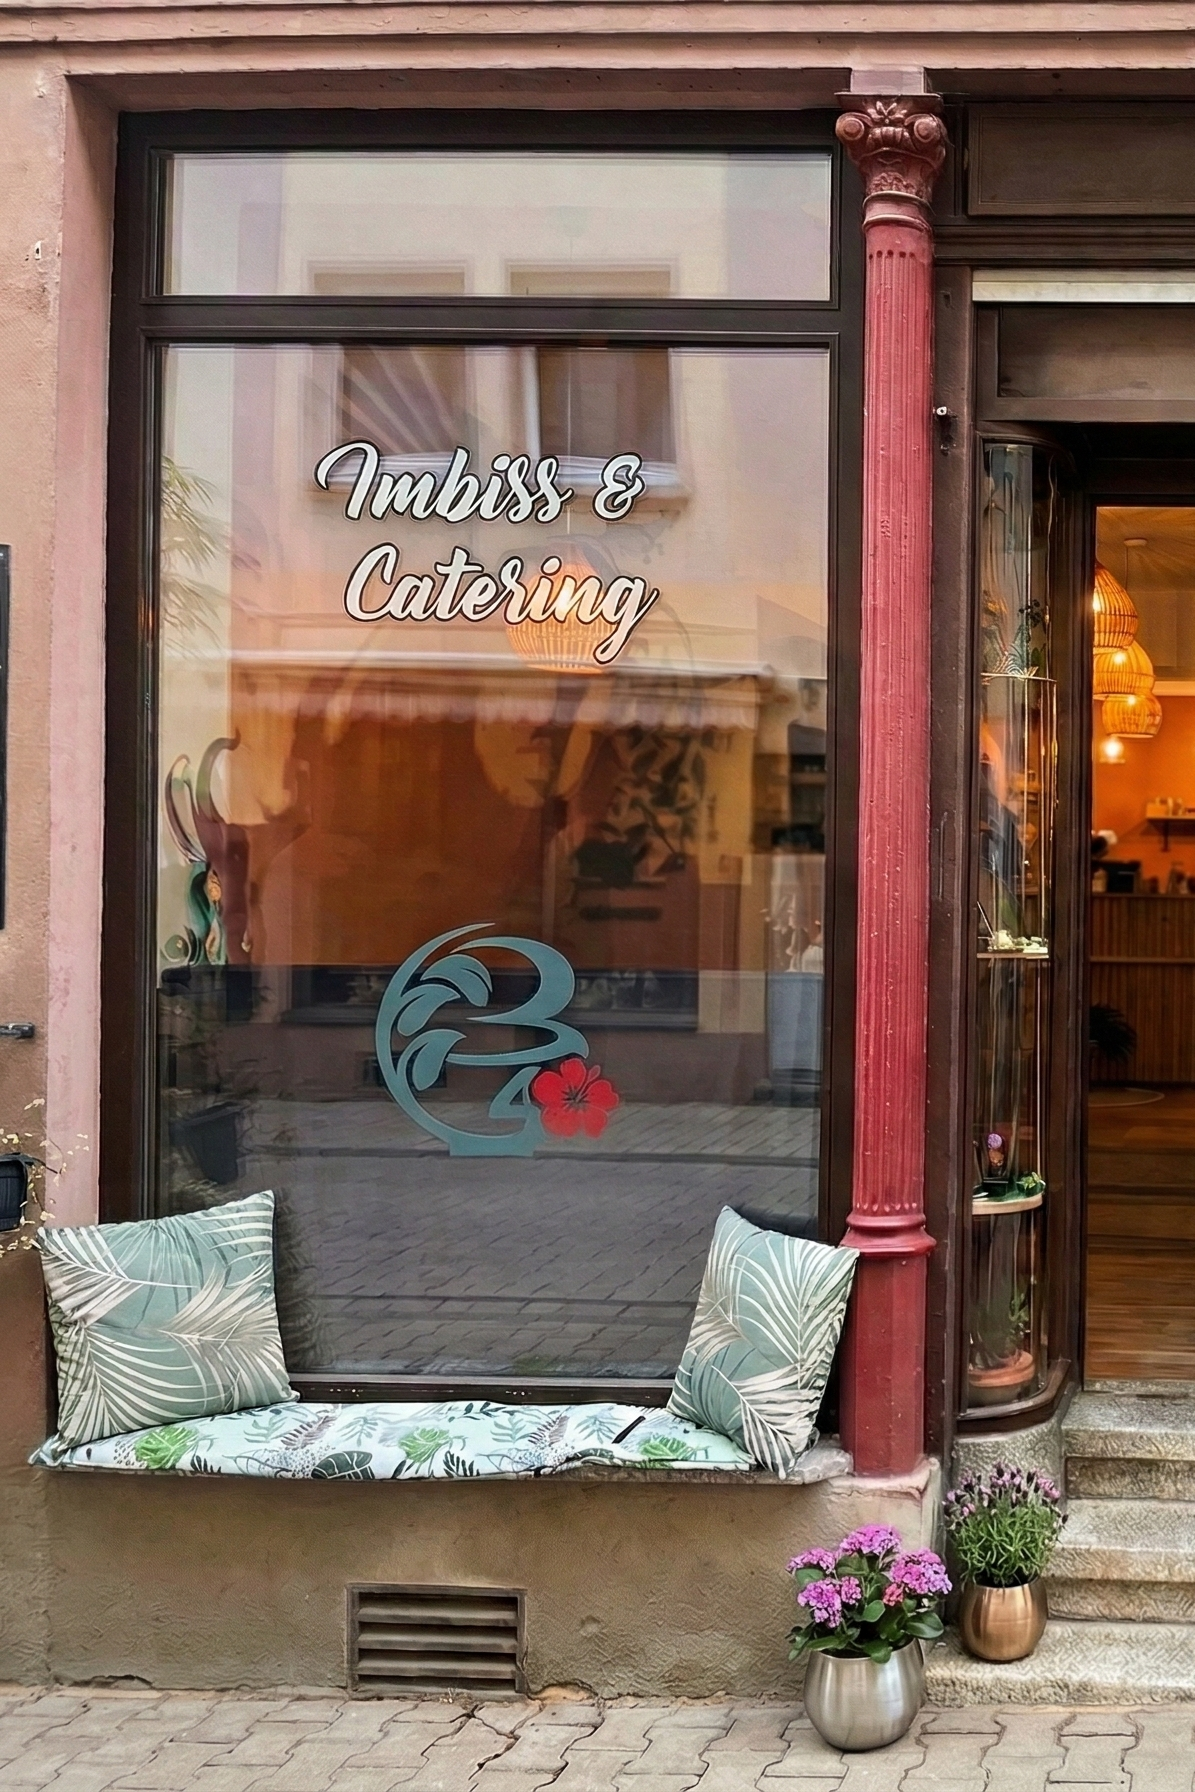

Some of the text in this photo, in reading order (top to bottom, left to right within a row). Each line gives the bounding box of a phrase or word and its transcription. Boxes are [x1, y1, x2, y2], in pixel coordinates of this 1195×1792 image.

[315, 439, 646, 524] Imbiss &
[344, 542, 660, 664] Catering
